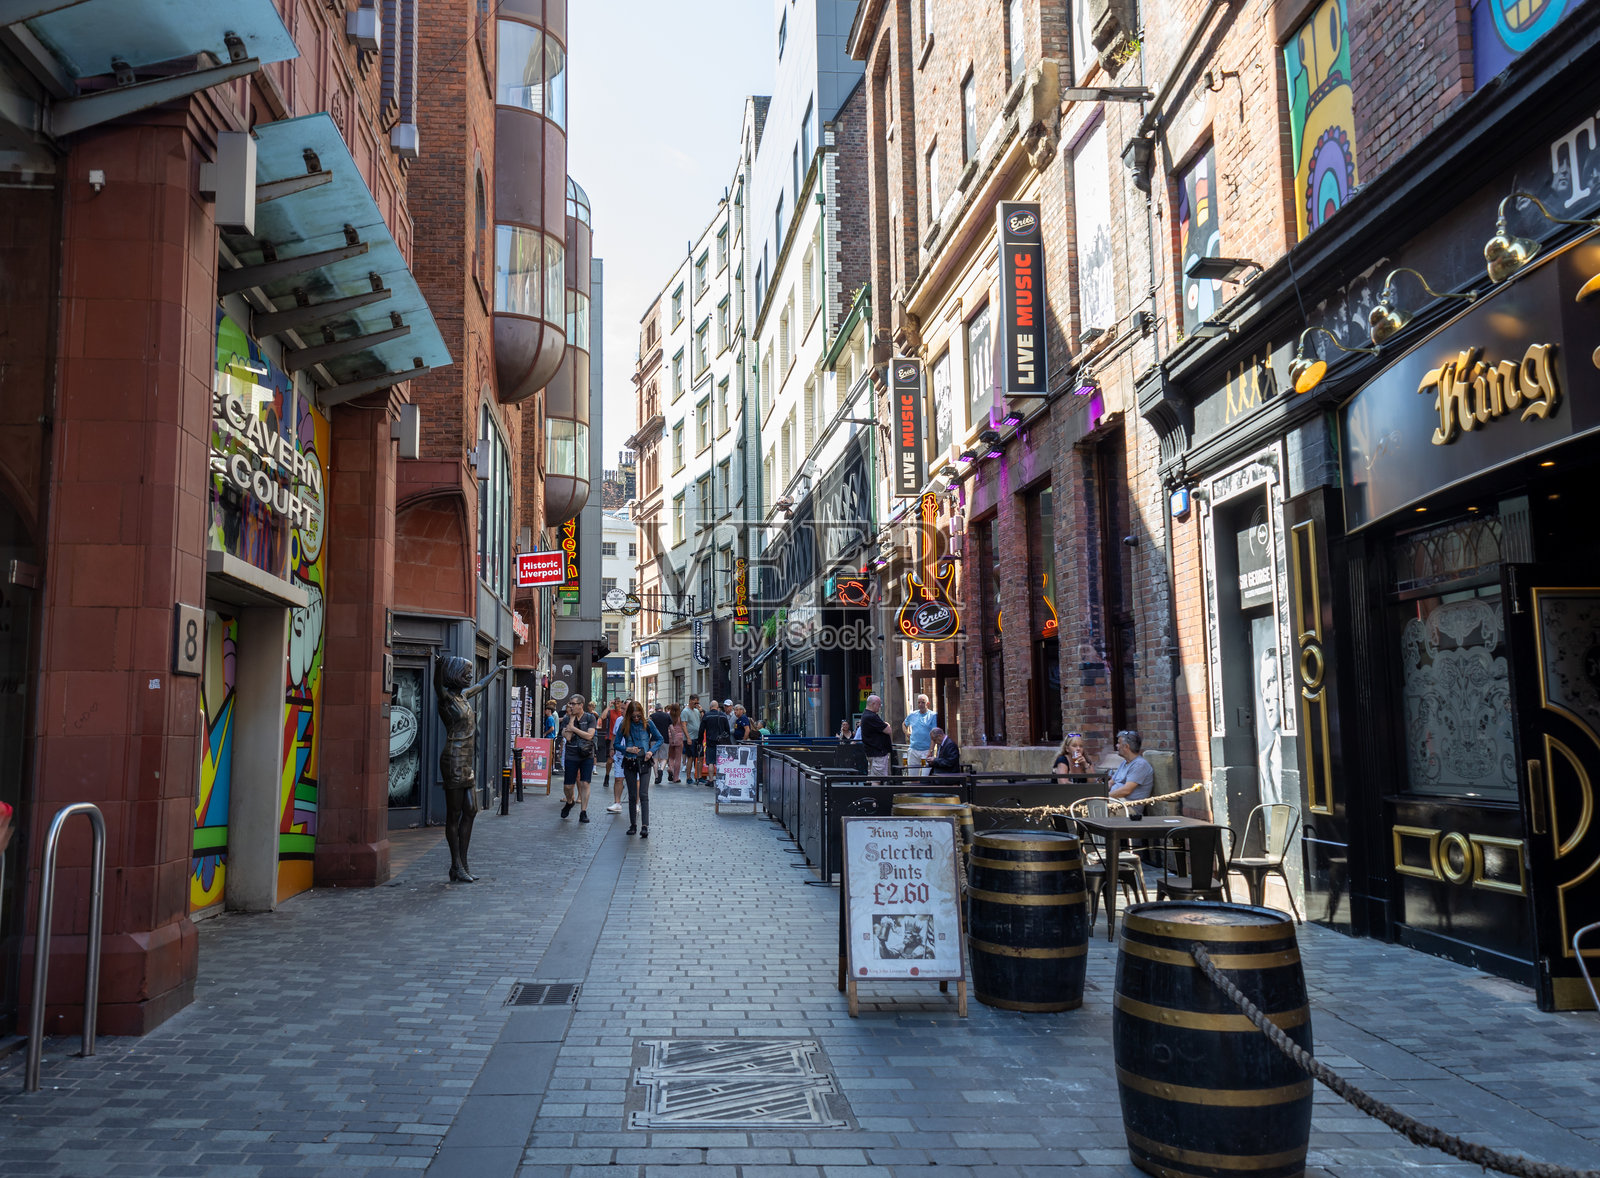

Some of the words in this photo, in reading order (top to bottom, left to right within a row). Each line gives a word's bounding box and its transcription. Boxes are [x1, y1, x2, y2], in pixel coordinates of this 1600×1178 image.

[1010, 214, 1035, 231] Eric's
[1014, 253, 1033, 327] MUSIC
[1017, 333, 1035, 385] LIVE
[1417, 343, 1556, 446] King
[901, 395, 915, 448] MUSIC
[222, 393, 321, 494] CAVERN
[902, 452, 916, 489] LIVE
[227, 454, 315, 533] COURT
[562, 517, 578, 579] avern
[520, 568, 561, 579] Liverpool
[523, 560, 558, 570] Historic
[918, 607, 949, 628] Eric's
[185, 619, 197, 661] 8
[388, 661, 392, 685] 8
[867, 826, 898, 840] King
[904, 826, 933, 839] John
[865, 842, 933, 861] Selected
[879, 862, 922, 880] Pints
[873, 882, 930, 906] £2.60
